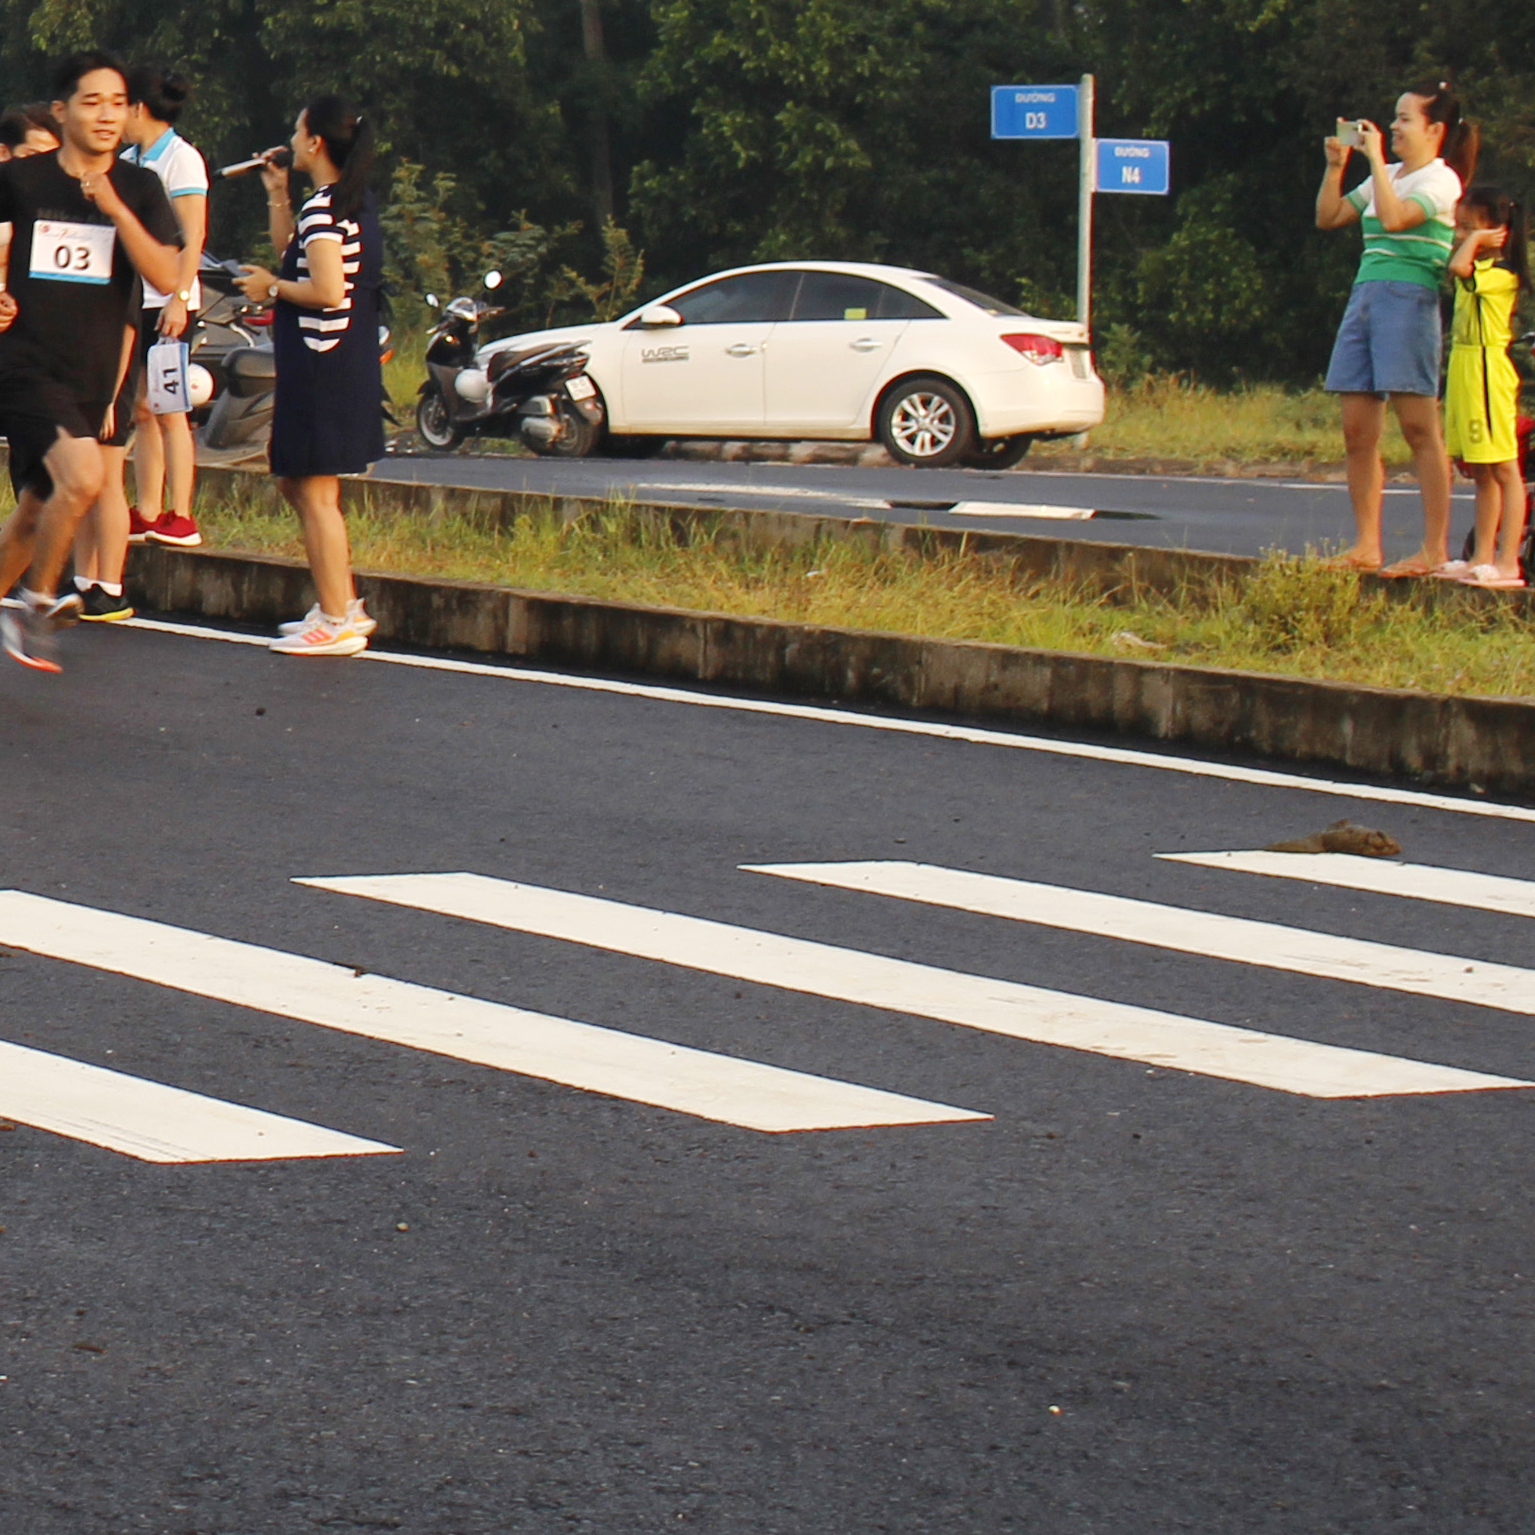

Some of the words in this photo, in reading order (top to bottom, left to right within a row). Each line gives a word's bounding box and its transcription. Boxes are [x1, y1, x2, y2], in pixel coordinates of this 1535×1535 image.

[1025, 112, 1047, 129] D3
[1121, 166, 1142, 183] N4
[54, 245, 90, 271] 03
[641, 345, 690, 358] WRC
[163, 367, 180, 395] 41
